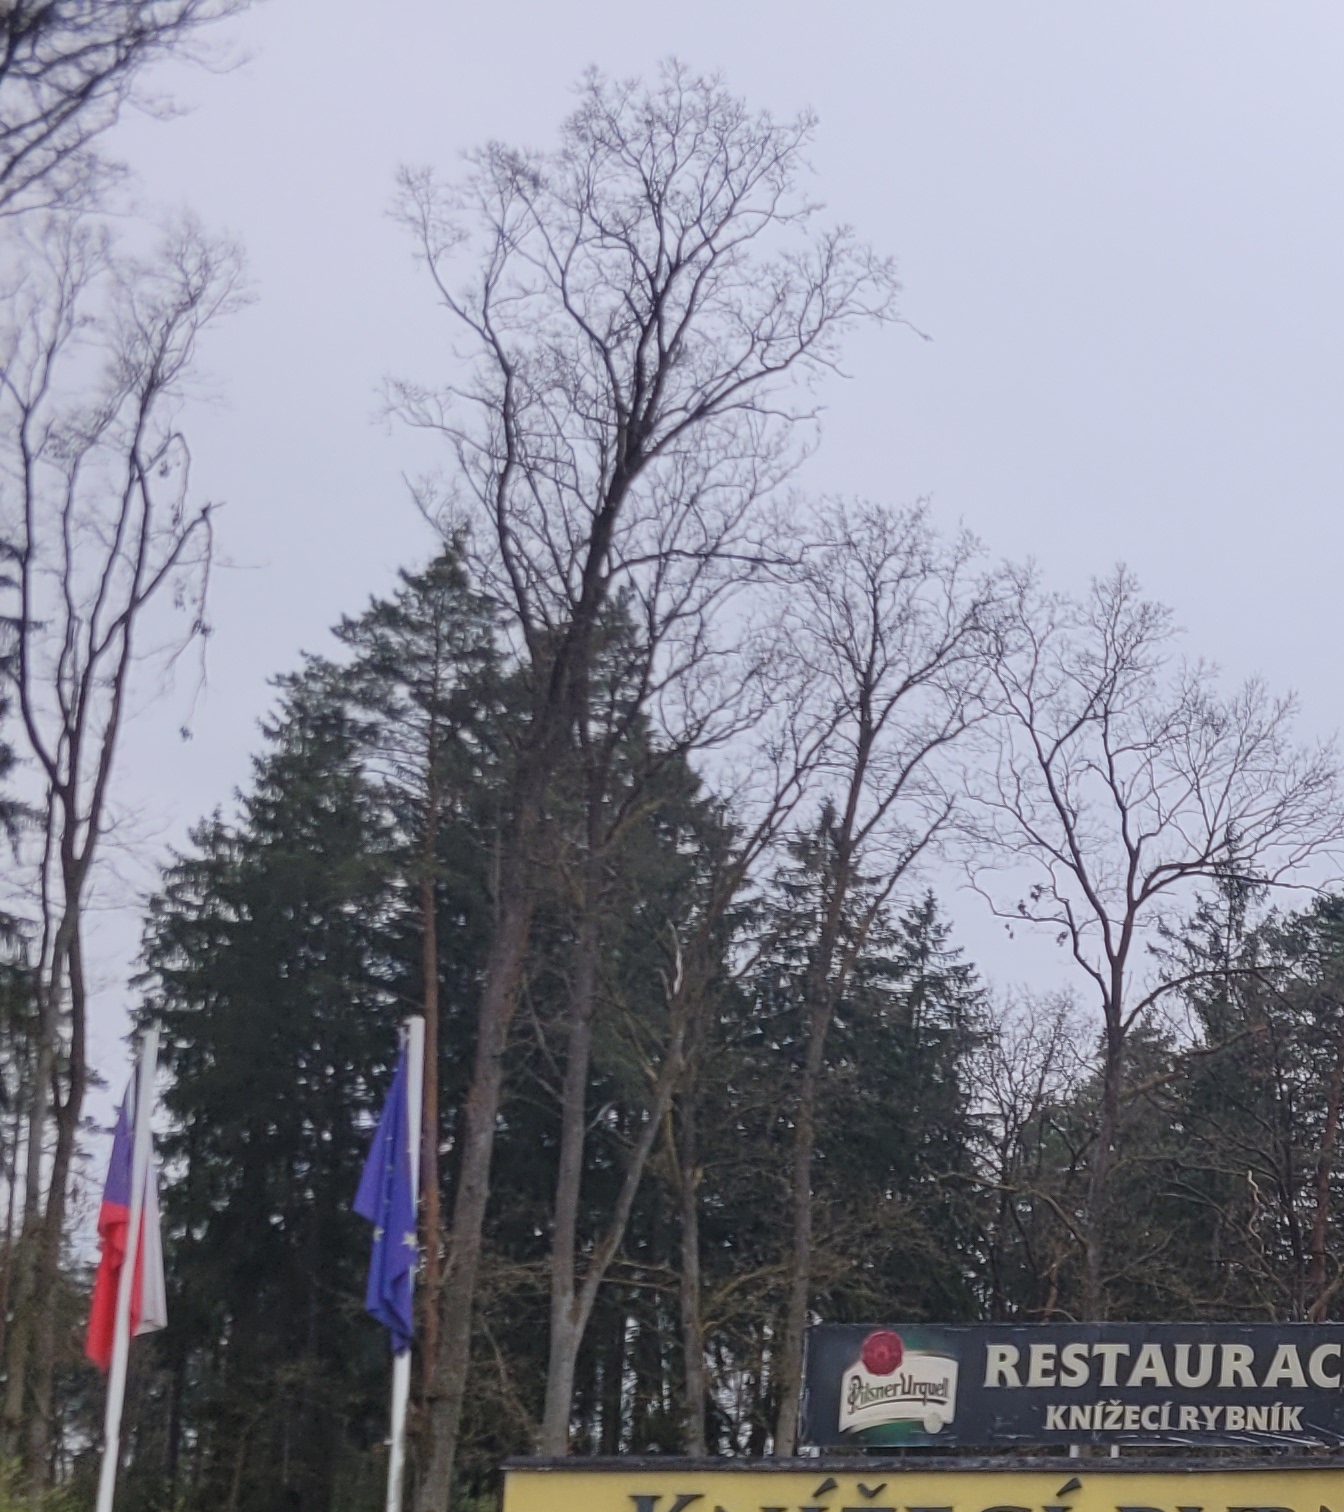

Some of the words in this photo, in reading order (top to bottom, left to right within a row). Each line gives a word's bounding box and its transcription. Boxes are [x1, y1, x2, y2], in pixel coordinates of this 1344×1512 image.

[847, 1375, 902, 1415] Pilsner
[900, 1373, 950, 1406] Urquell
[1043, 1397, 1173, 1431] KNÍŽECÍ
[1178, 1401, 1304, 1432] RYBNÍK
